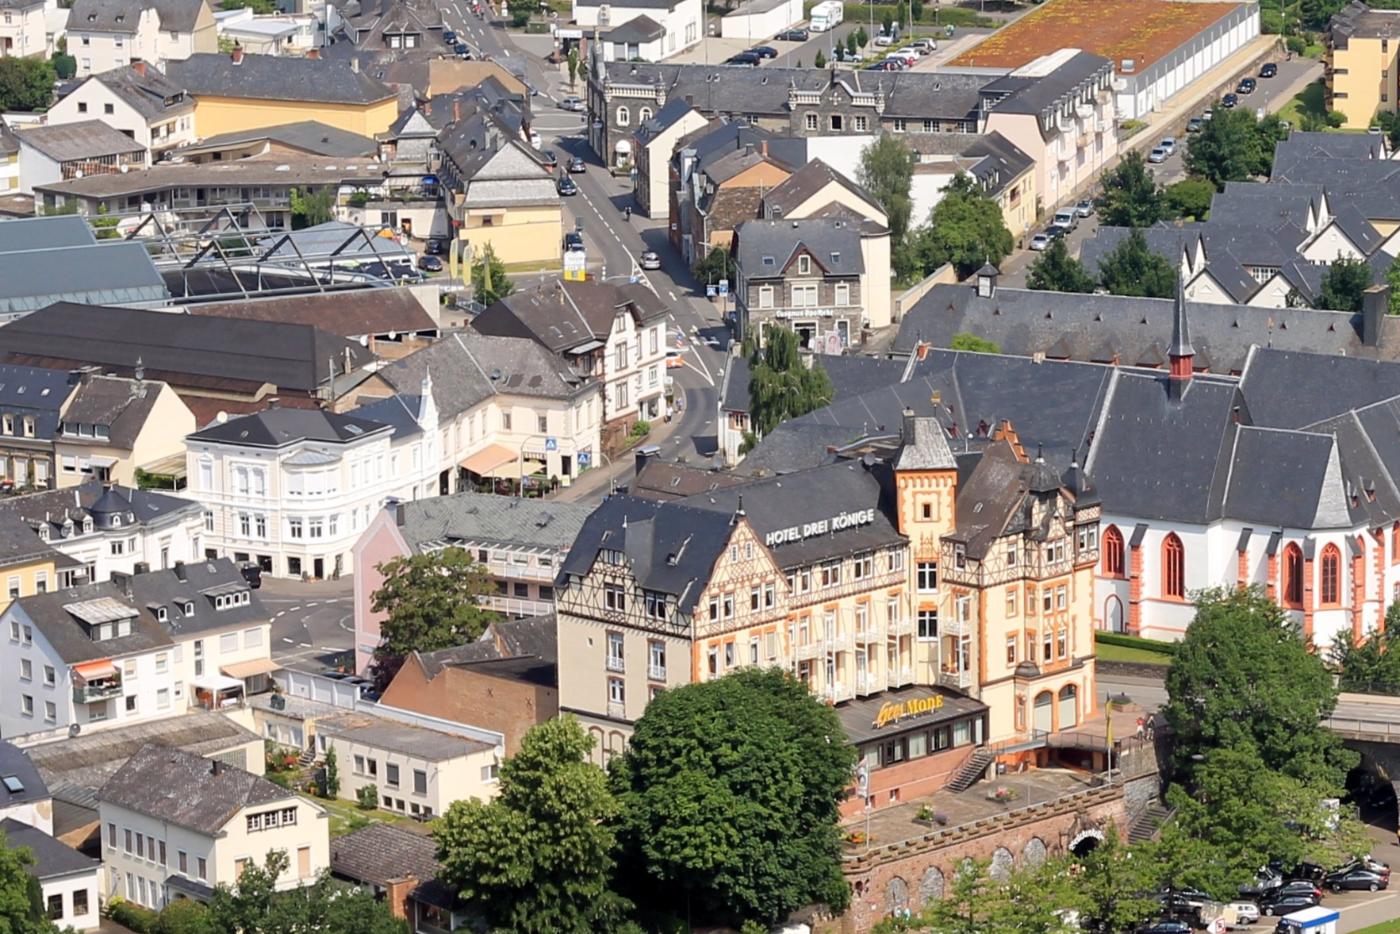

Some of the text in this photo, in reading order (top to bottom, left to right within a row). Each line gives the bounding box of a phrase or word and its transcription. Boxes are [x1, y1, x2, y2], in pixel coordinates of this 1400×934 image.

[766, 509, 874, 545] HOTEL DREI KÖNIGE
